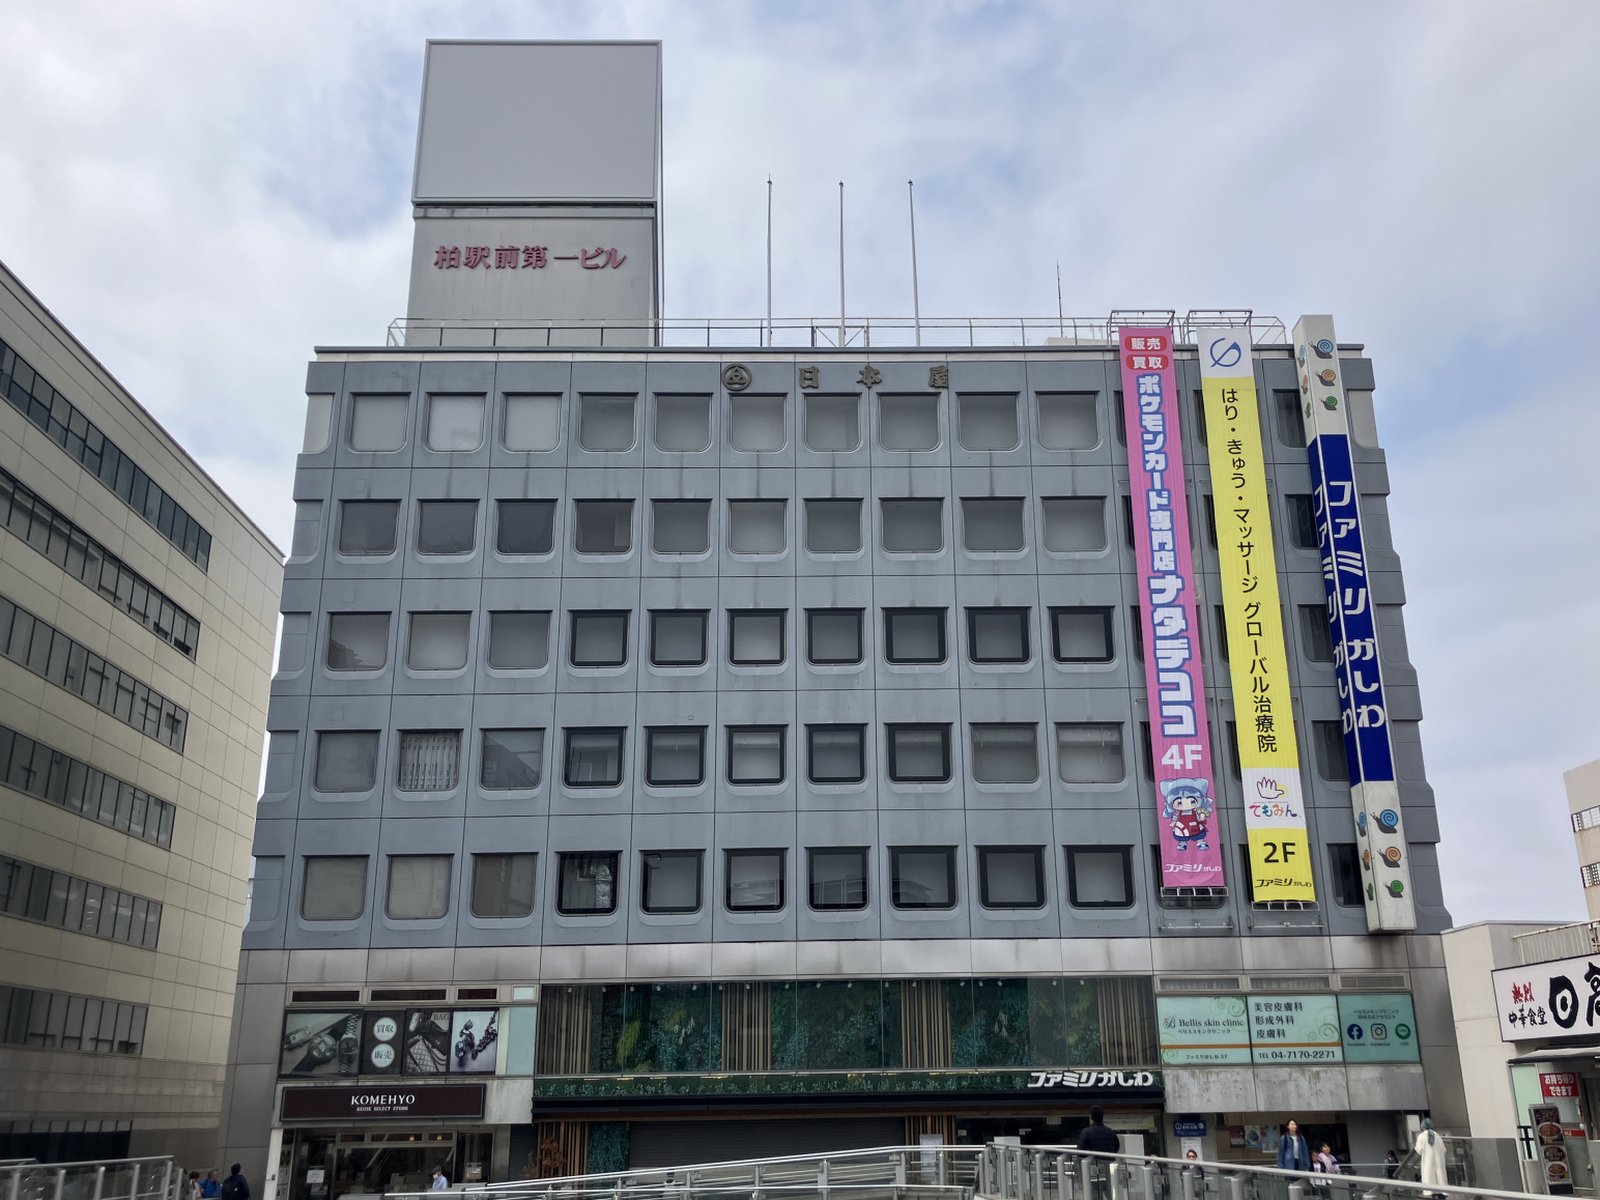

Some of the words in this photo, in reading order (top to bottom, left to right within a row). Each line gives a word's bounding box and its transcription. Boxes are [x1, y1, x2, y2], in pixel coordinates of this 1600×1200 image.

[434, 245, 627, 270] 柏駅前第一ビル
[1131, 337, 1161, 350] 販売
[1133, 356, 1162, 369] 買取
[1161, 744, 1202, 770] 4F
[1249, 803, 1298, 818] てもみん
[1263, 841, 1296, 863] 2F
[1511, 981, 1535, 1004] 熱烈
[1254, 1001, 1303, 1012] 美容皮膚科
[1255, 1015, 1294, 1025] 形成外科
[1508, 1003, 1548, 1028] 中華食堂
[1178, 1018, 1203, 1027] Bellis
[1204, 1018, 1220, 1027] skin
[1222, 1018, 1244, 1027] clinic
[1256, 1028, 1286, 1039] 皮膚科
[1271, 1050, 1335, 1059] 04-7170-2271
[1549, 1086, 1573, 1096] できます
[351, 1094, 416, 1105] KOMEHYO
